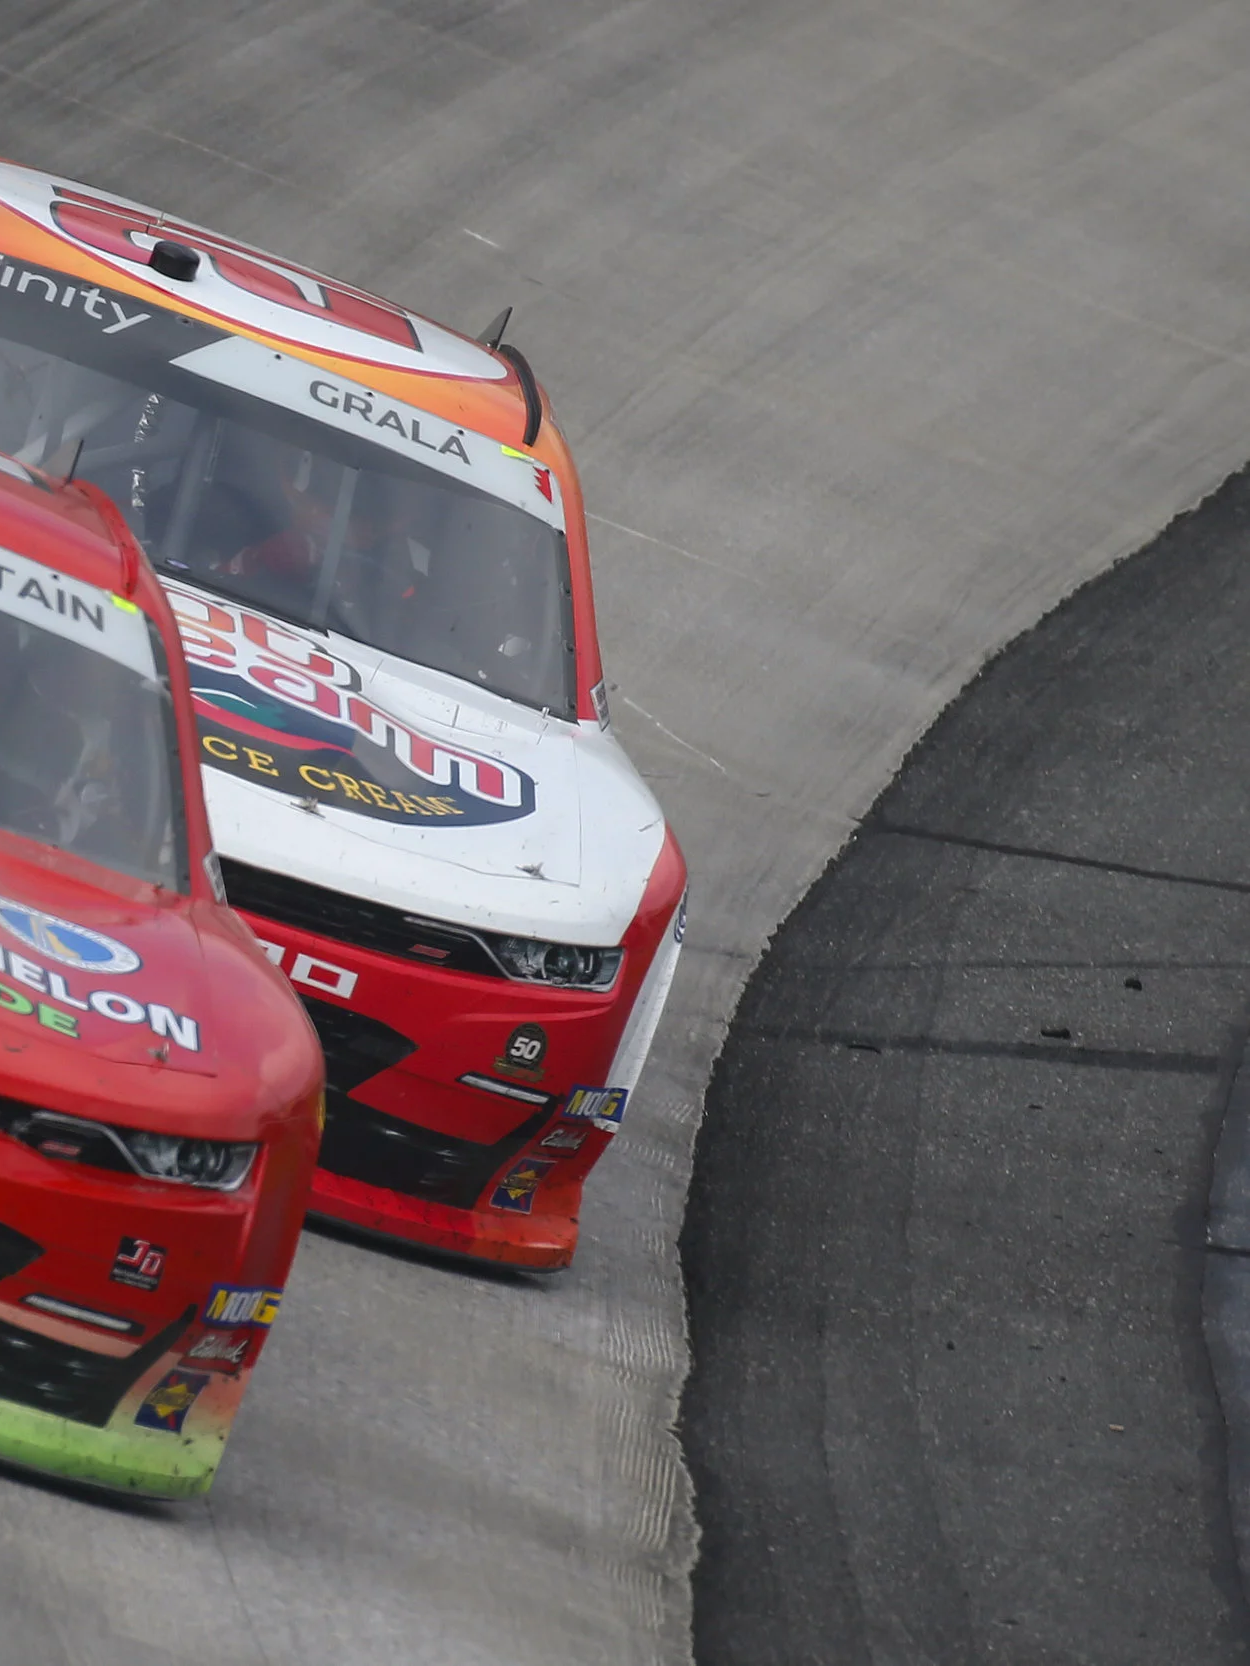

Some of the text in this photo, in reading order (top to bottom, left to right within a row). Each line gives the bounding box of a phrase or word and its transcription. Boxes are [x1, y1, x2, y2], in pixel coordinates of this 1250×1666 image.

[309, 380, 472, 466] GRALA
[202, 735, 465, 816] CE CREAM
[510, 1037, 541, 1060] 50
[206, 1289, 284, 1325] MOOG
